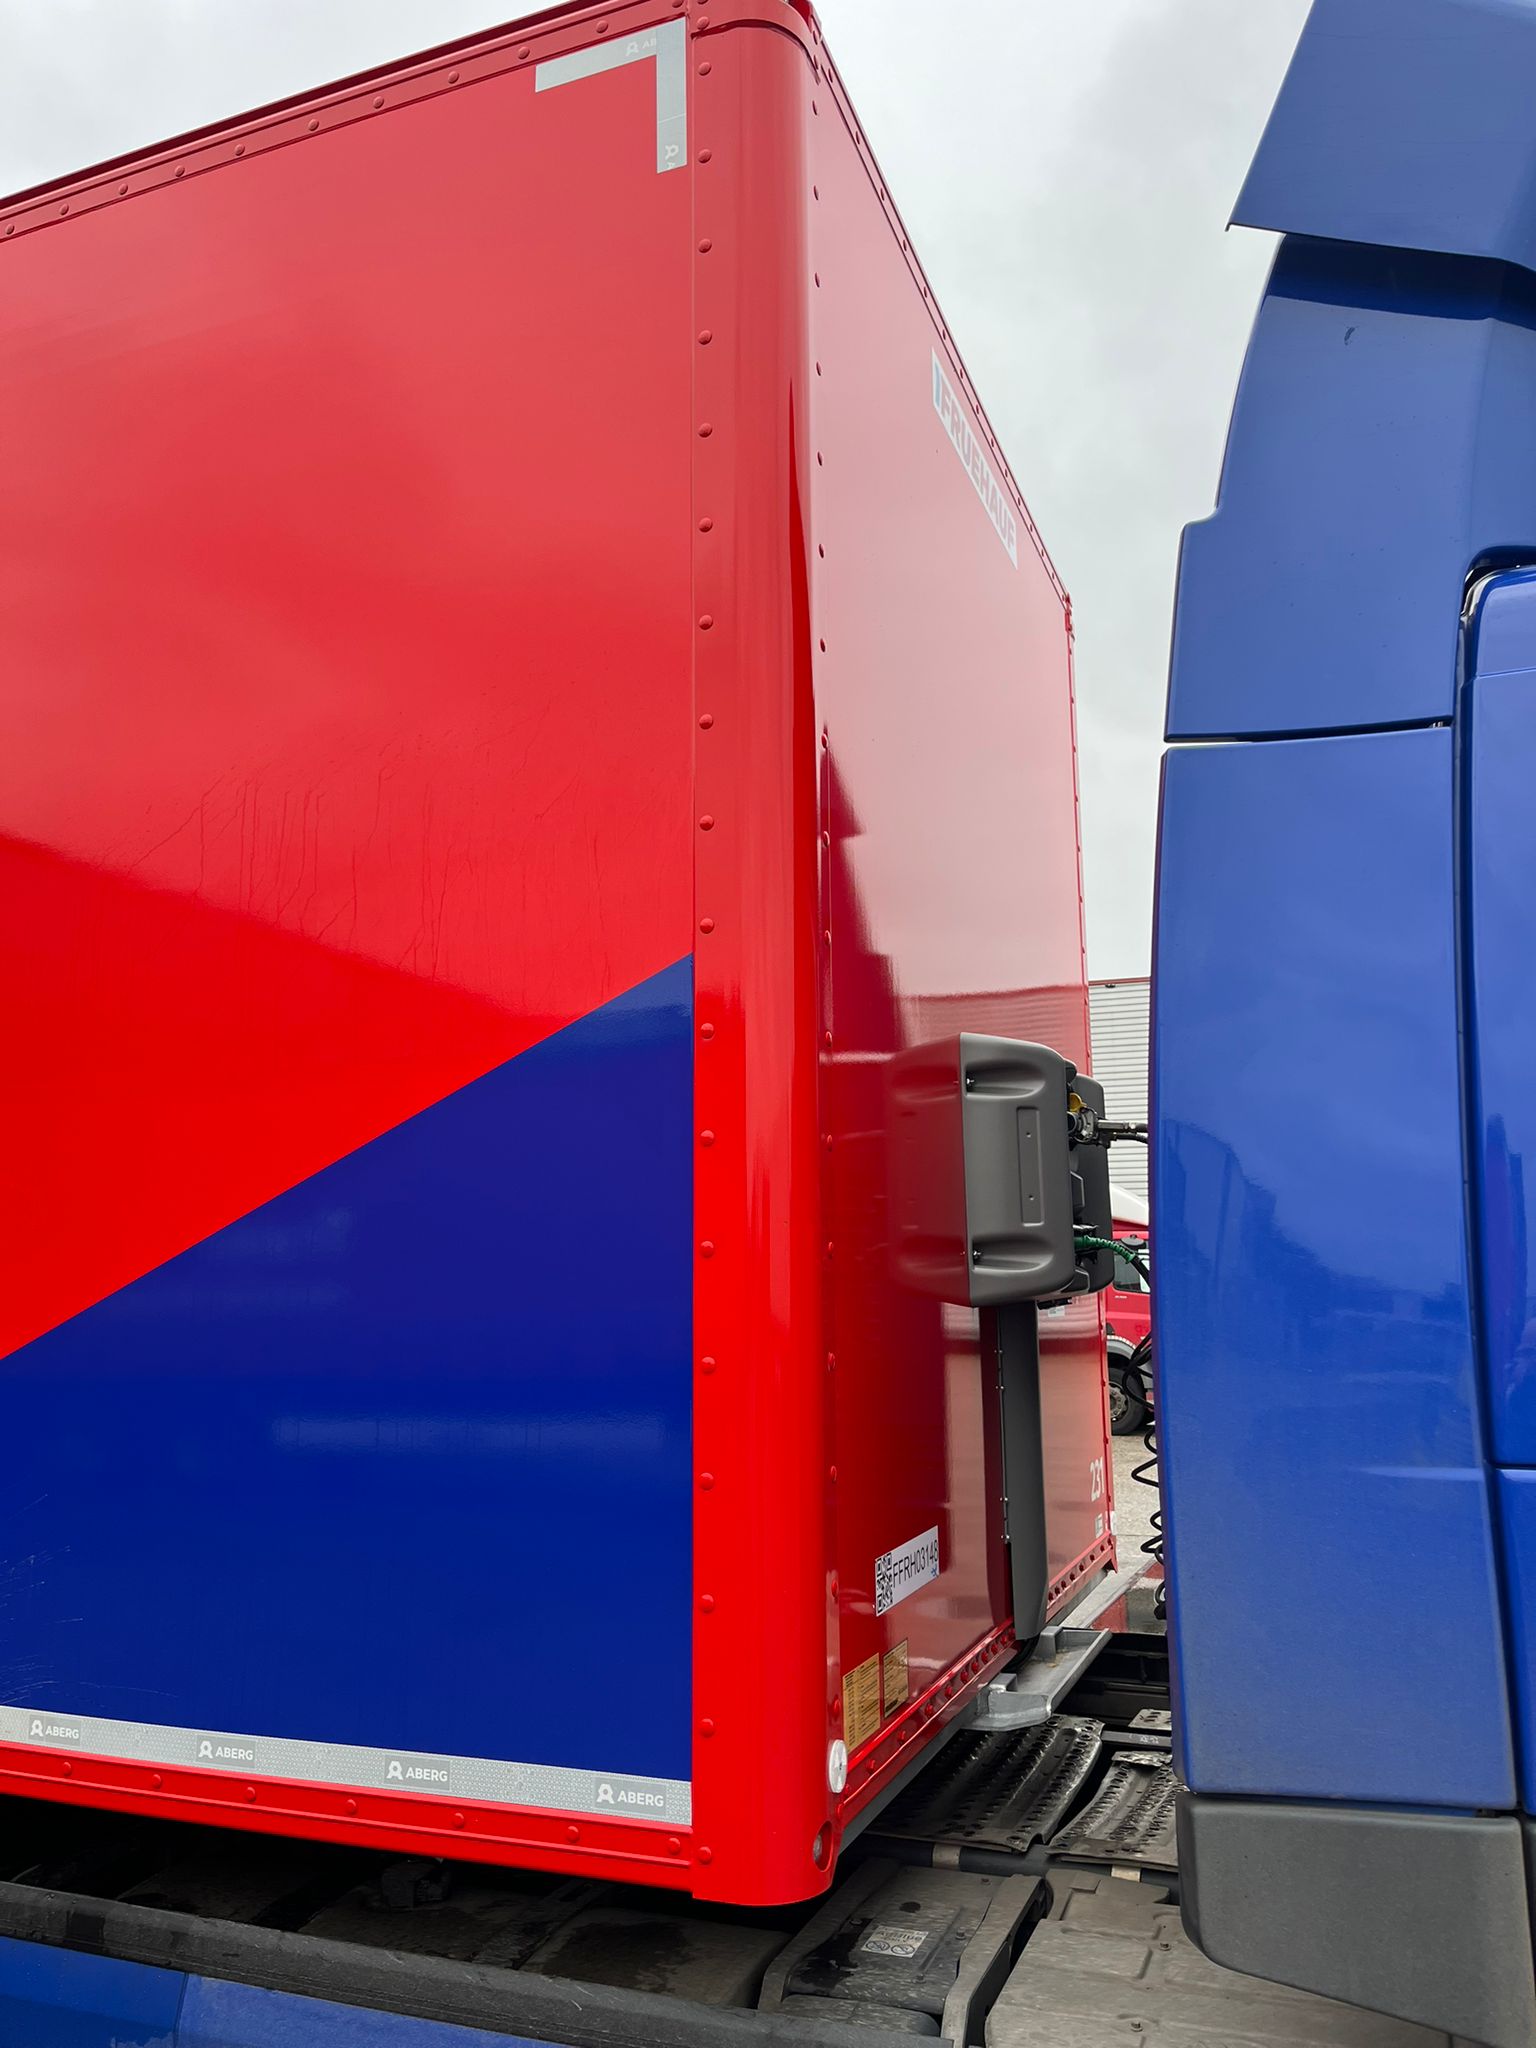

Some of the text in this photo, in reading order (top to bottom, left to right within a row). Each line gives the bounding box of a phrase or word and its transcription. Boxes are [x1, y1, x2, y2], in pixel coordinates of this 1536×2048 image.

[941, 372, 1016, 549] FRUEHAUF
[1089, 1455, 1105, 1502] 231
[45, 1725, 80, 1740] ABERG
[215, 1746, 254, 1761] ABERG
[405, 1767, 449, 1782] ABERG
[617, 1790, 664, 1807] ABERG
